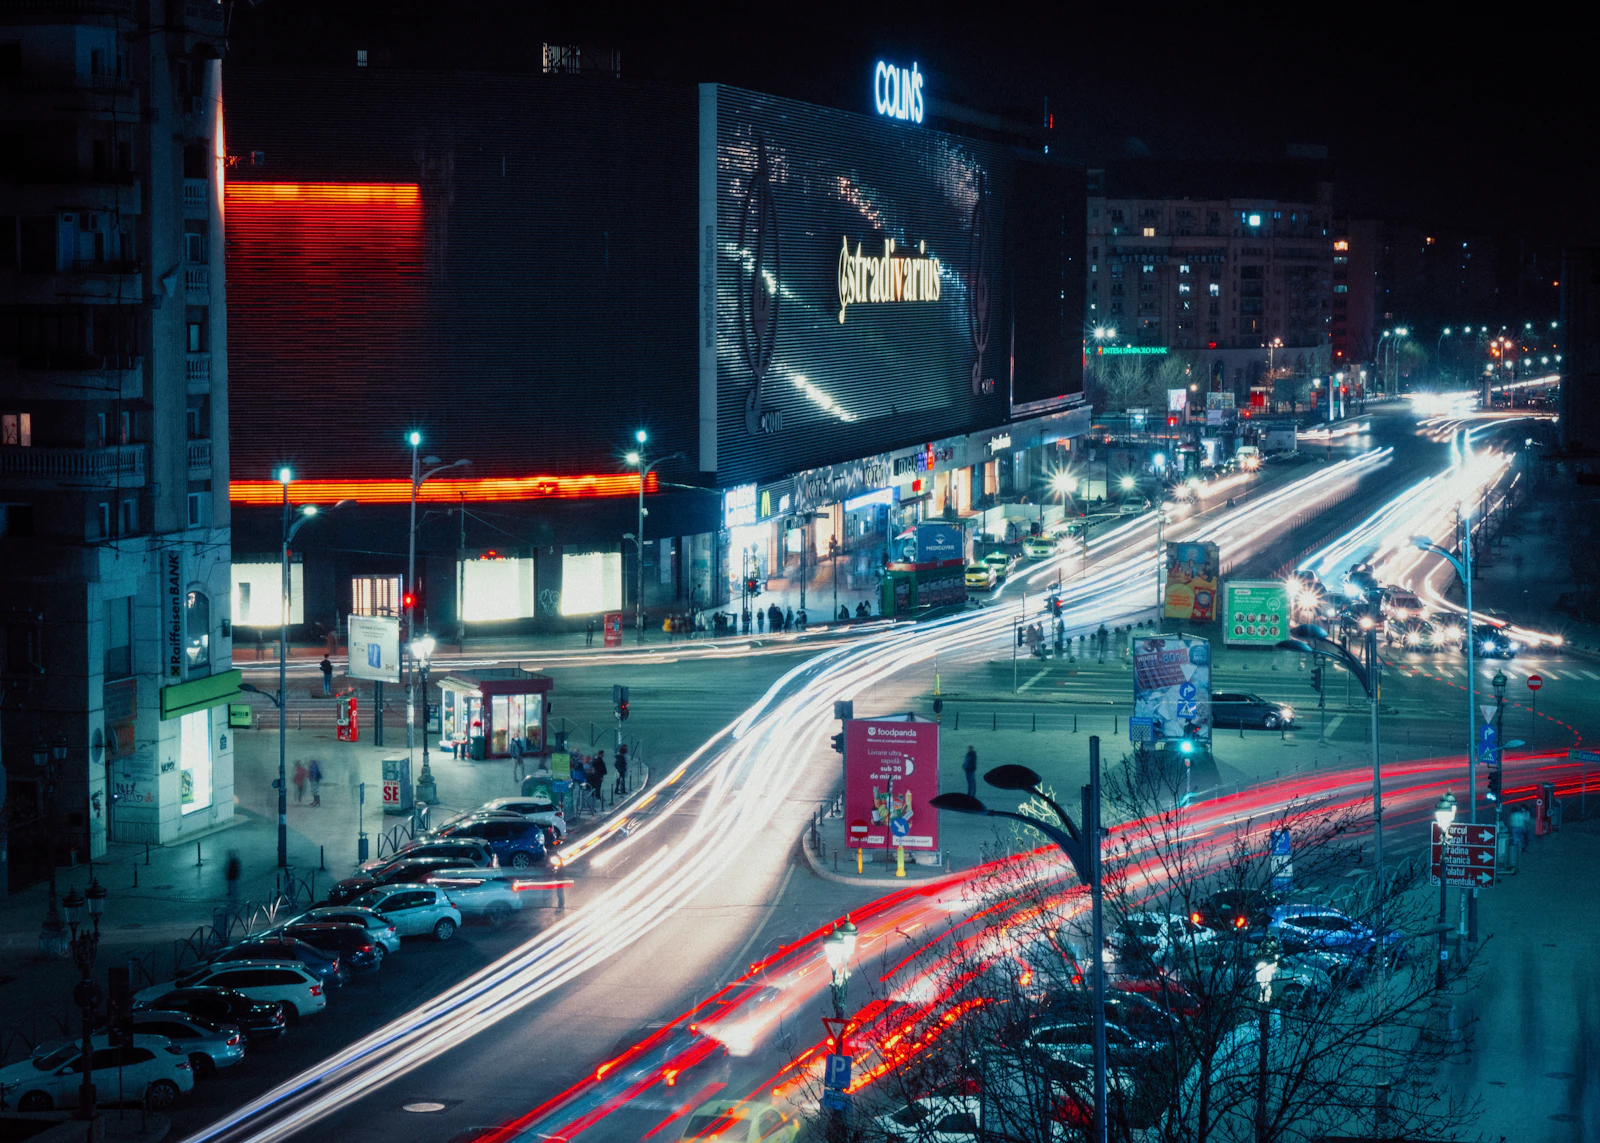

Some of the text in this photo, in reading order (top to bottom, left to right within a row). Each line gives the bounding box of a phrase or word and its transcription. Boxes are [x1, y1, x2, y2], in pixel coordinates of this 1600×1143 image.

[875, 60, 924, 123] COLIN'S
[838, 234, 941, 324] stradivarius
[168, 551, 181, 665] Raiffeisen BANK
[1136, 654, 1158, 662] WINTER
[877, 727, 917, 738] foodpanda
[383, 785, 399, 801] SE
[1447, 825, 1468, 835] arcul
[1446, 845, 1469, 855] rădina
[1446, 867, 1465, 876] alatul
[831, 1055, 846, 1083] P
